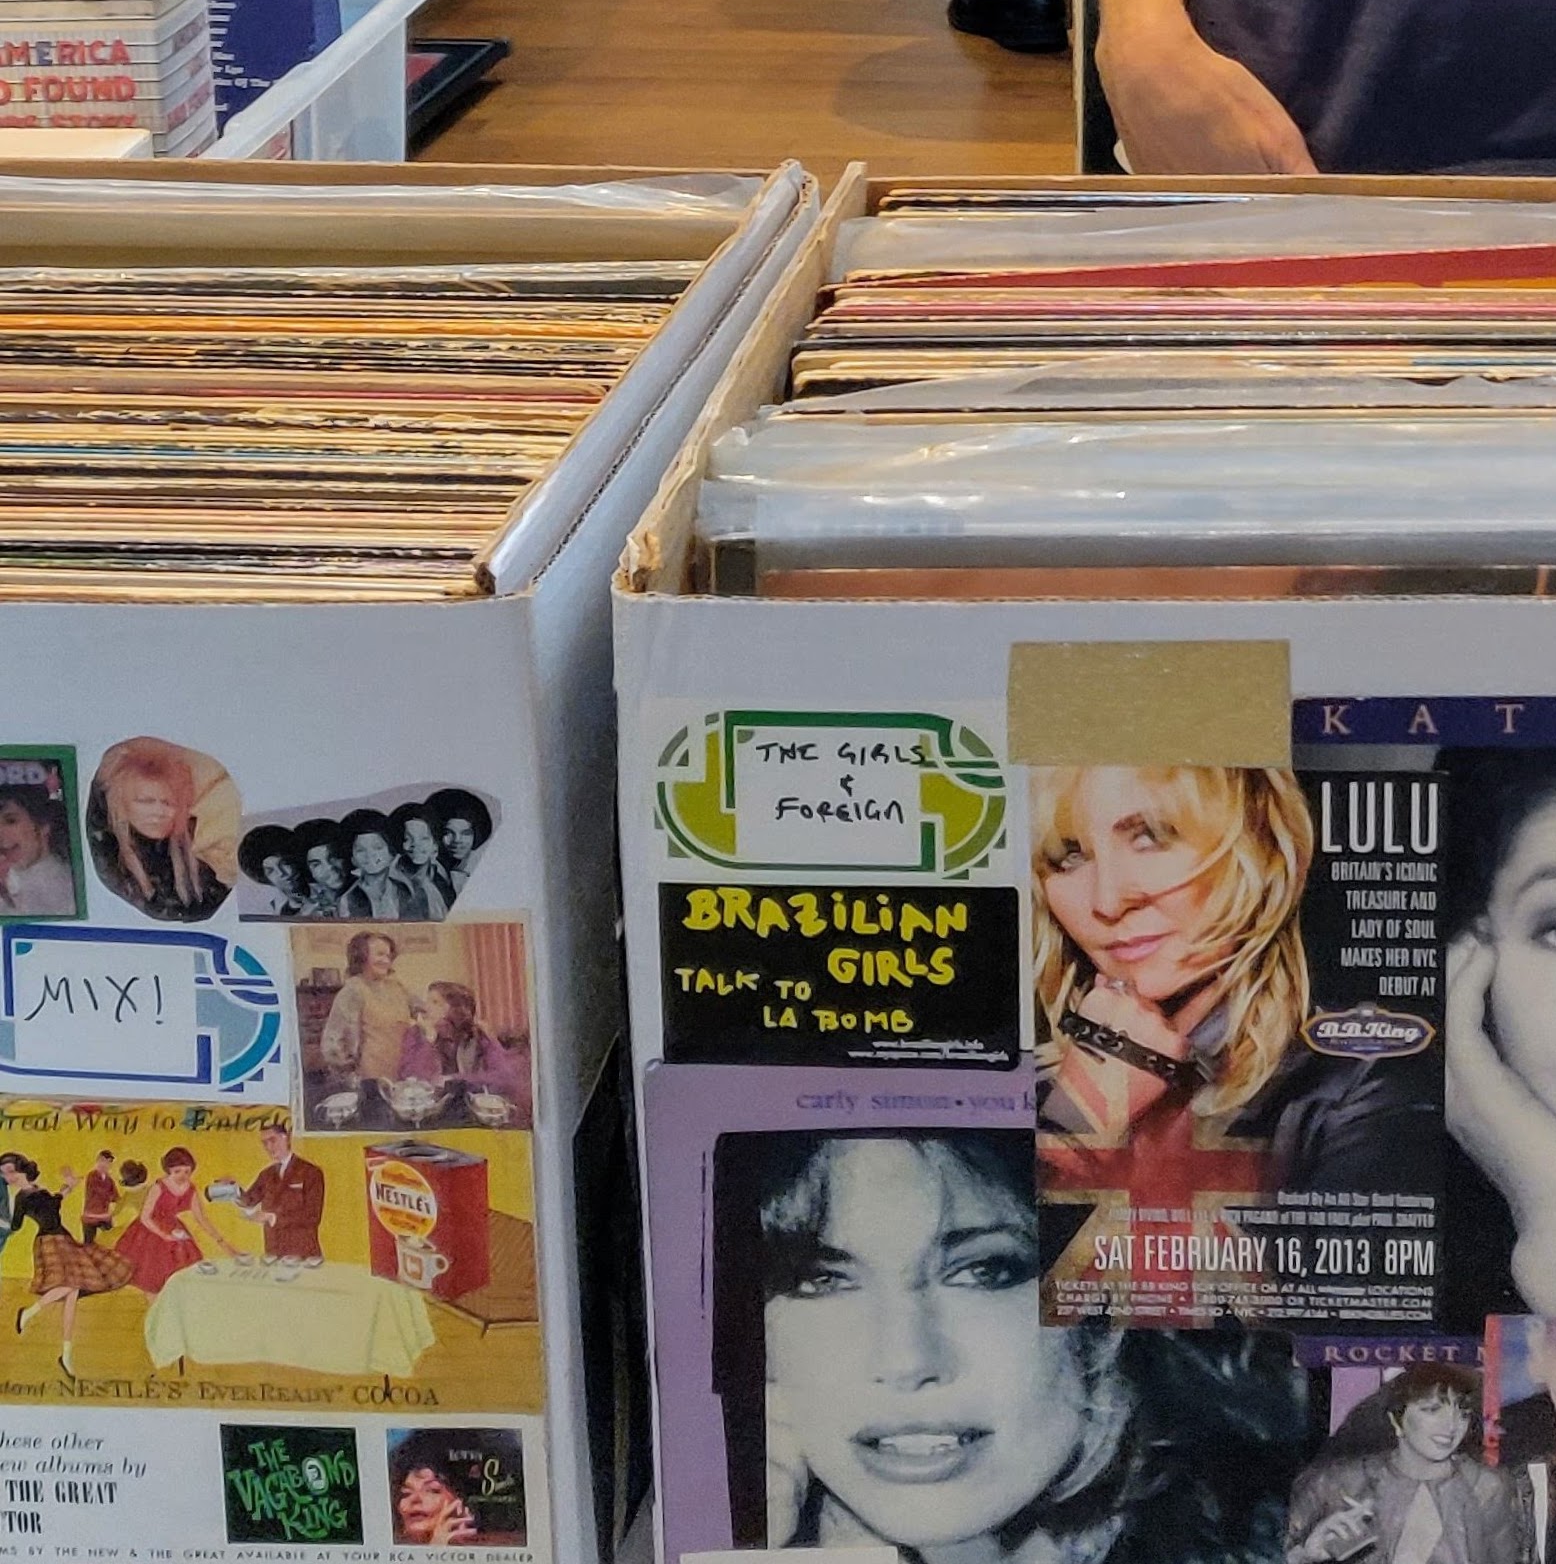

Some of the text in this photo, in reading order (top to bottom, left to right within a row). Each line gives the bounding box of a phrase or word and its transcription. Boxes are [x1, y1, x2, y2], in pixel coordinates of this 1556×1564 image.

[0, 40, 131, 67] MERICA
[24, 76, 136, 102] FOUND
[756, 742, 927, 766] THE GIRLS
[775, 796, 905, 825] FOREIGN
[1321, 780, 1439, 855] LULU
[1331, 861, 1438, 882] BRITAIN'S ICONIC
[1345, 890, 1437, 911] TREASURE AND
[1351, 918, 1437, 939] LADY OF SOUL
[827, 946, 955, 987] GIRLS
[1340, 947, 1438, 968] MAKES HER NYC
[673, 967, 812, 1001] TALK TO
[1379, 976, 1437, 997] DEBUT AT
[23, 973, 165, 1026] MIX!
[763, 1005, 914, 1034] LA BOMB
[796, 1091, 858, 1117] carly
[76, 1110, 139, 1135] Way
[152, 1111, 176, 1132] to
[1094, 1234, 1436, 1278] SAT FEBRUARY 16, 2013 8PM
[1055, 1281, 1098, 1291] TICKETS
[1368, 1286, 1434, 1297] LOCATIONS
[1324, 1345, 1460, 1363] ROCKET
[352, 1384, 440, 1407] COCOA
[50, 1432, 105, 1451] other
[247, 1437, 290, 1471] THE
[34, 1455, 116, 1477] albums
[121, 1457, 148, 1479] by
[4, 1479, 118, 1505] THE GREAT
[226, 1449, 357, 1521] VAGABOND
[1, 1510, 43, 1535] TOR
[277, 1496, 349, 1541] KING
[55, 1547, 79, 1558] THE
[88, 1548, 119, 1558] NEW
[150, 1549, 173, 1560] THE
[183, 1550, 226, 1561] GREAT
[236, 1550, 306, 1562] AVAILABLE
[316, 1552, 332, 1562] AT
[344, 1552, 381, 1562] YOUR
[389, 1552, 415, 1563] RCA
[426, 1552, 476, 1563] VICTOR
[486, 1553, 534, 1564] DEALER
